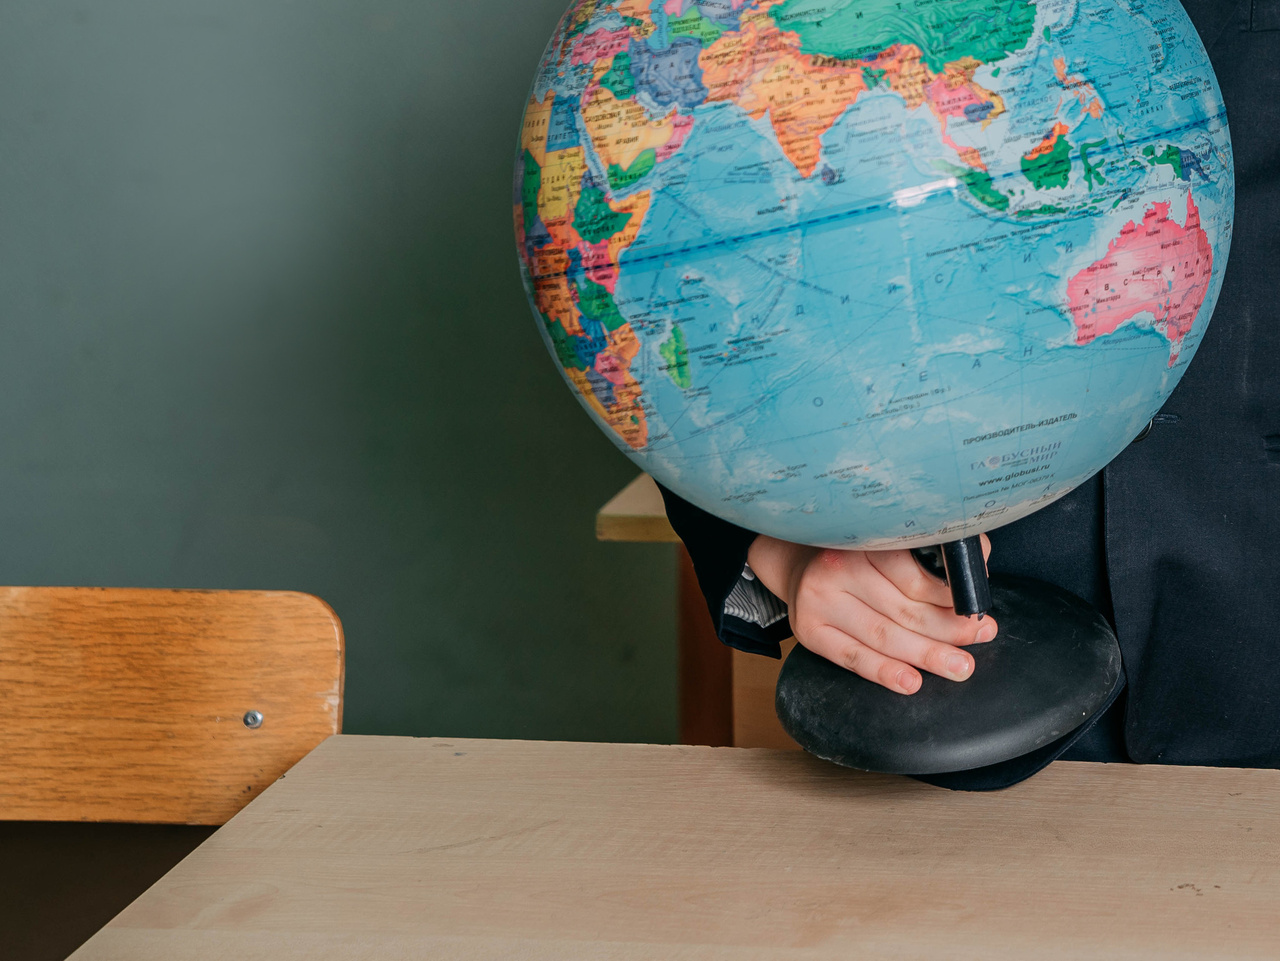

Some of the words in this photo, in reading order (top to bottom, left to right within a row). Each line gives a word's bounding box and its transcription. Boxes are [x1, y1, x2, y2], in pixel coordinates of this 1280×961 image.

[769, 78, 846, 102] ИНДИЯ
[1084, 254, 1209, 295] АВСТРАЛИЯ
[813, 345, 1034, 408] ОКЕАН
[963, 412, 1078, 446] ПРОИЗВОДИТЕЛЬ-ИЗДАТЕЛЬ
[1028, 451, 1058, 465] МИР
